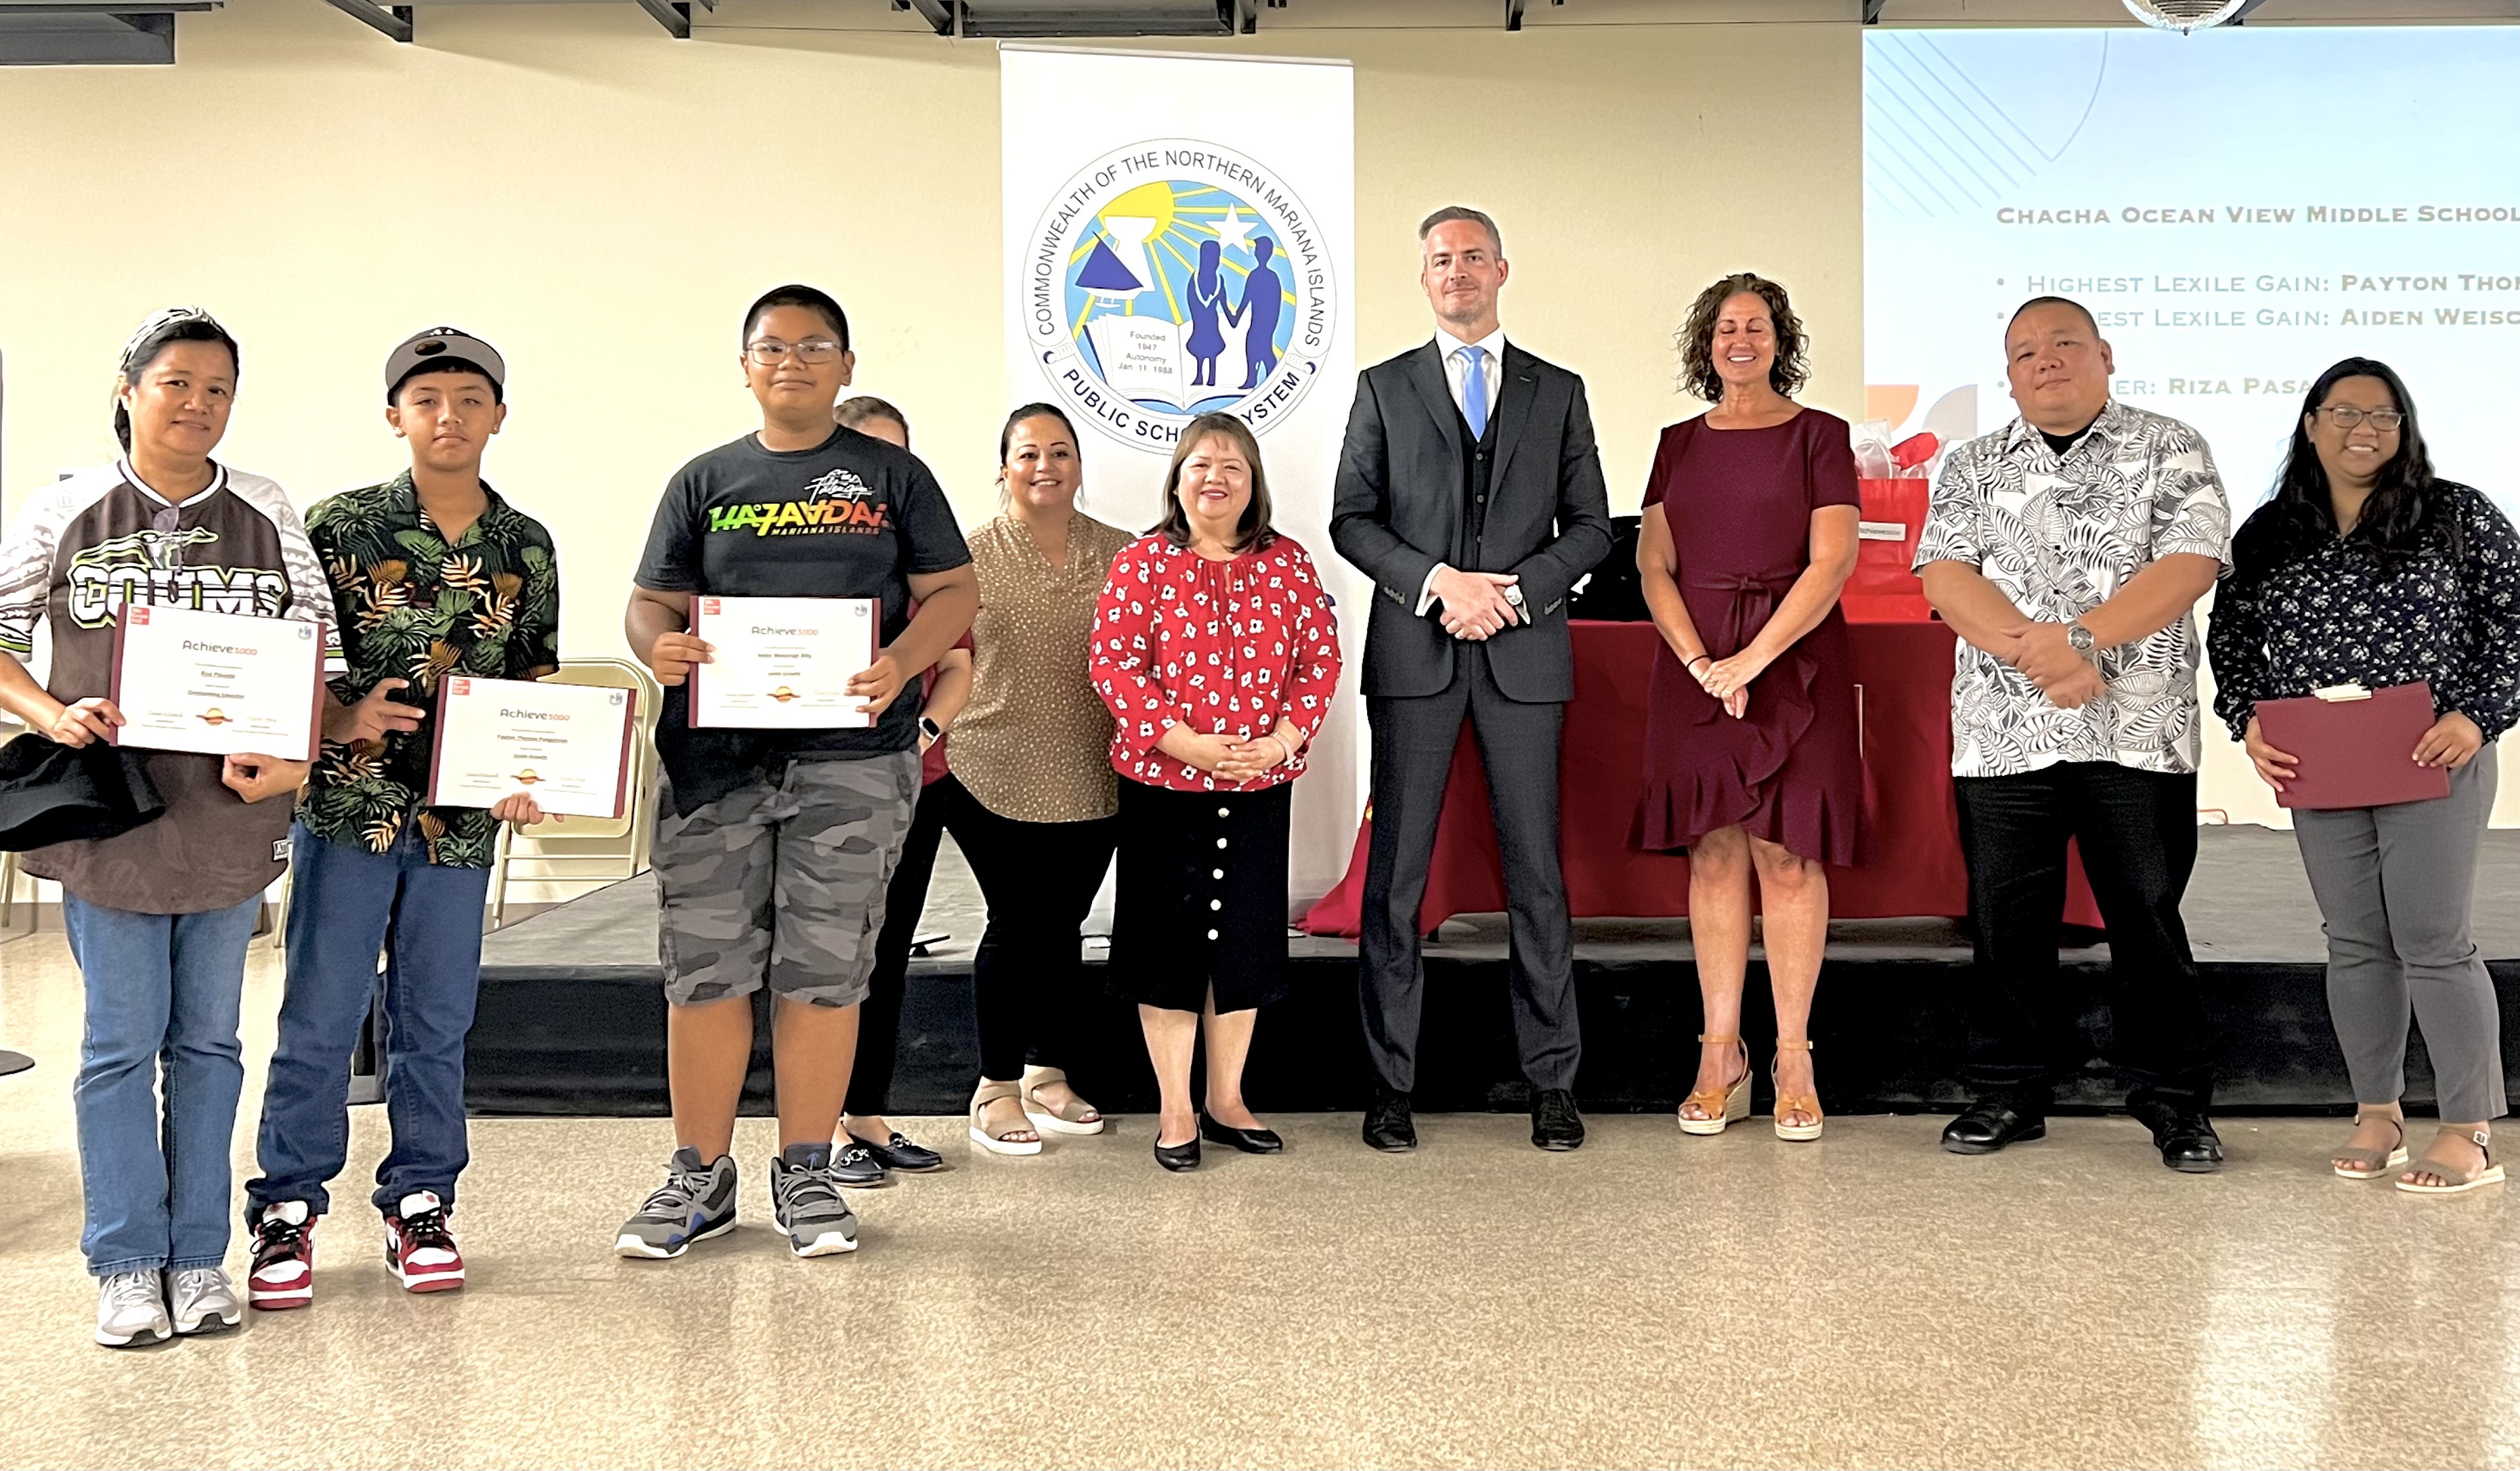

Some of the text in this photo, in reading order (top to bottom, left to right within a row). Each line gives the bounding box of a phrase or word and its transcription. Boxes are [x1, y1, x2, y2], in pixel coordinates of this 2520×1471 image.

[1034, 150, 1325, 347] COMMONWEALTH OF THE NORTHERN MARIANA ISLANDS
[1129, 330, 1166, 342] Founded
[1137, 342, 1158, 351] 1947
[1125, 352, 1167, 365] Autonomy
[1153, 366, 1173, 374] 1988
[1063, 369, 1301, 443] PUBLIC SCH YSTEM
[770, 525, 825, 536] MARIANA
[181, 640, 258, 656] Achieve3000
